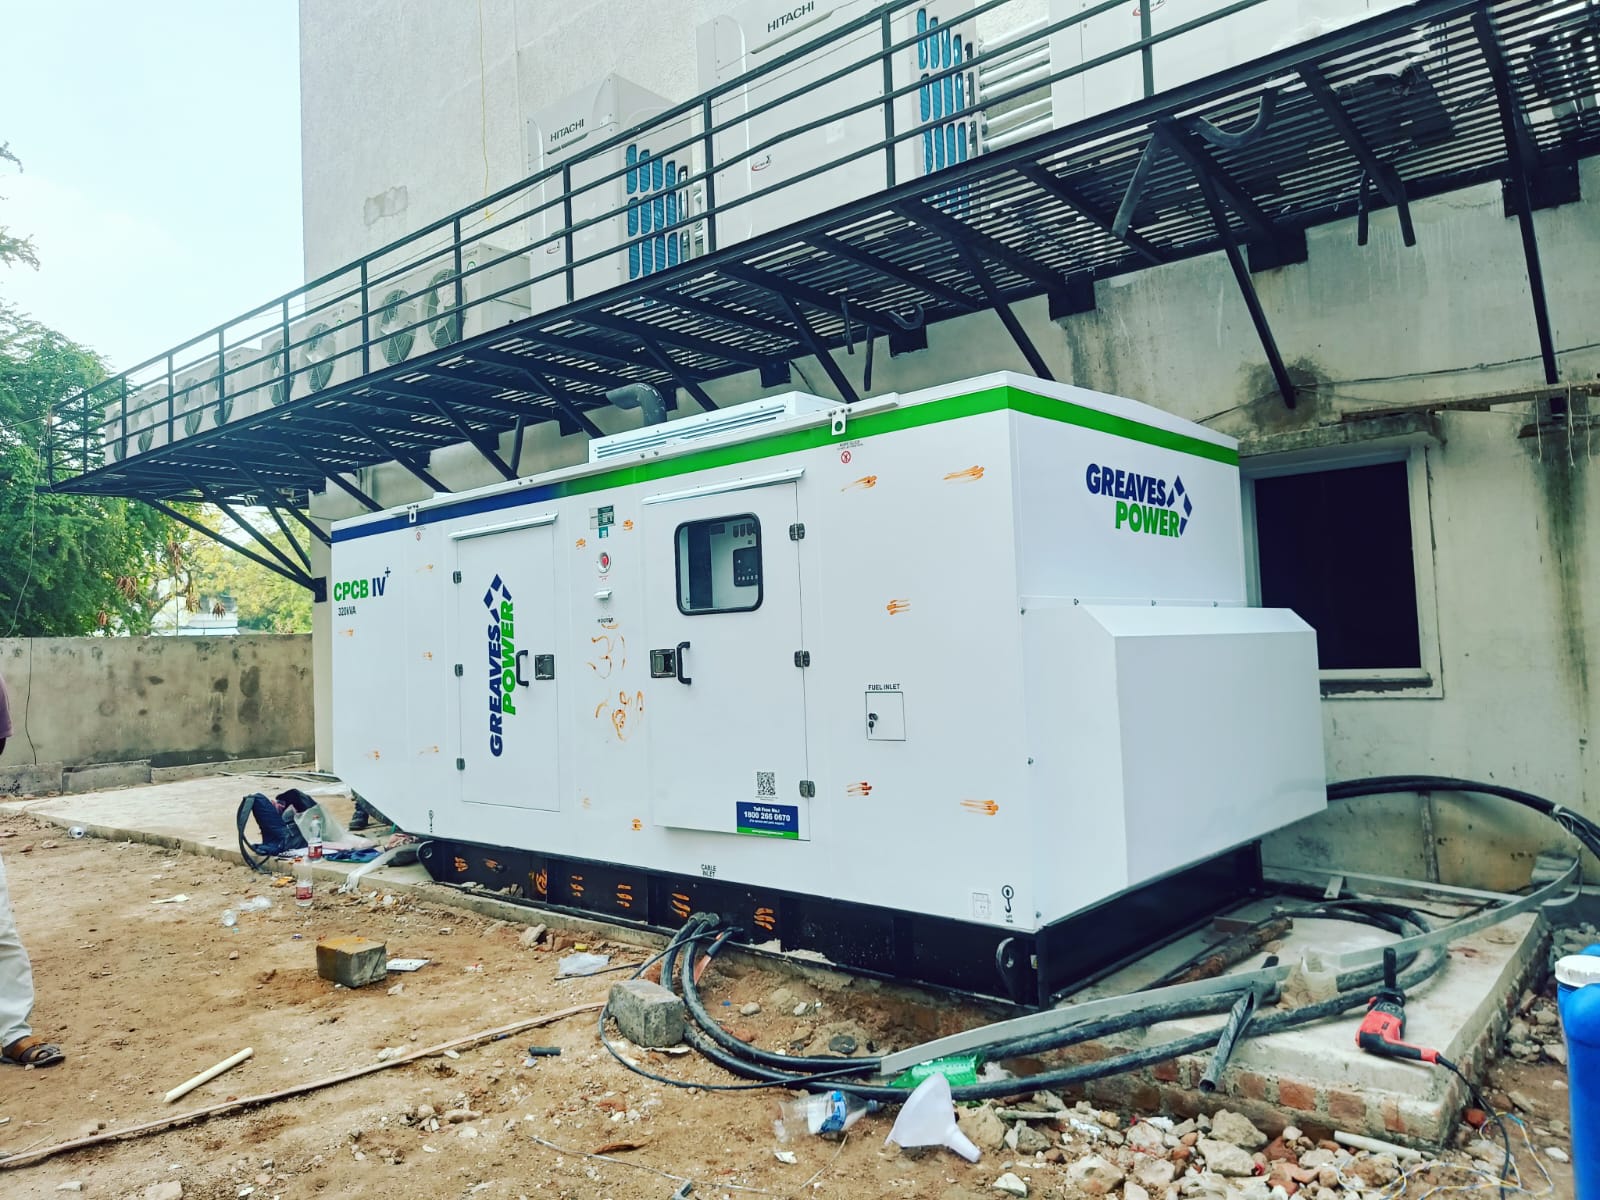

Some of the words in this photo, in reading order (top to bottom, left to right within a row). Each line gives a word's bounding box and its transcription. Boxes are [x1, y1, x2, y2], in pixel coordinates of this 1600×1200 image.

[768, 1, 814, 33] HITACHI
[550, 118, 584, 142] HITACHI
[1086, 463, 1166, 507] GREAVES
[1115, 500, 1180, 538] POWER
[333, 579, 369, 602] CPCB
[501, 600, 516, 715] POWER
[488, 624, 503, 757] GREAVES
[743, 811, 760, 819] 1800
[702, 870, 716, 879] INLET
